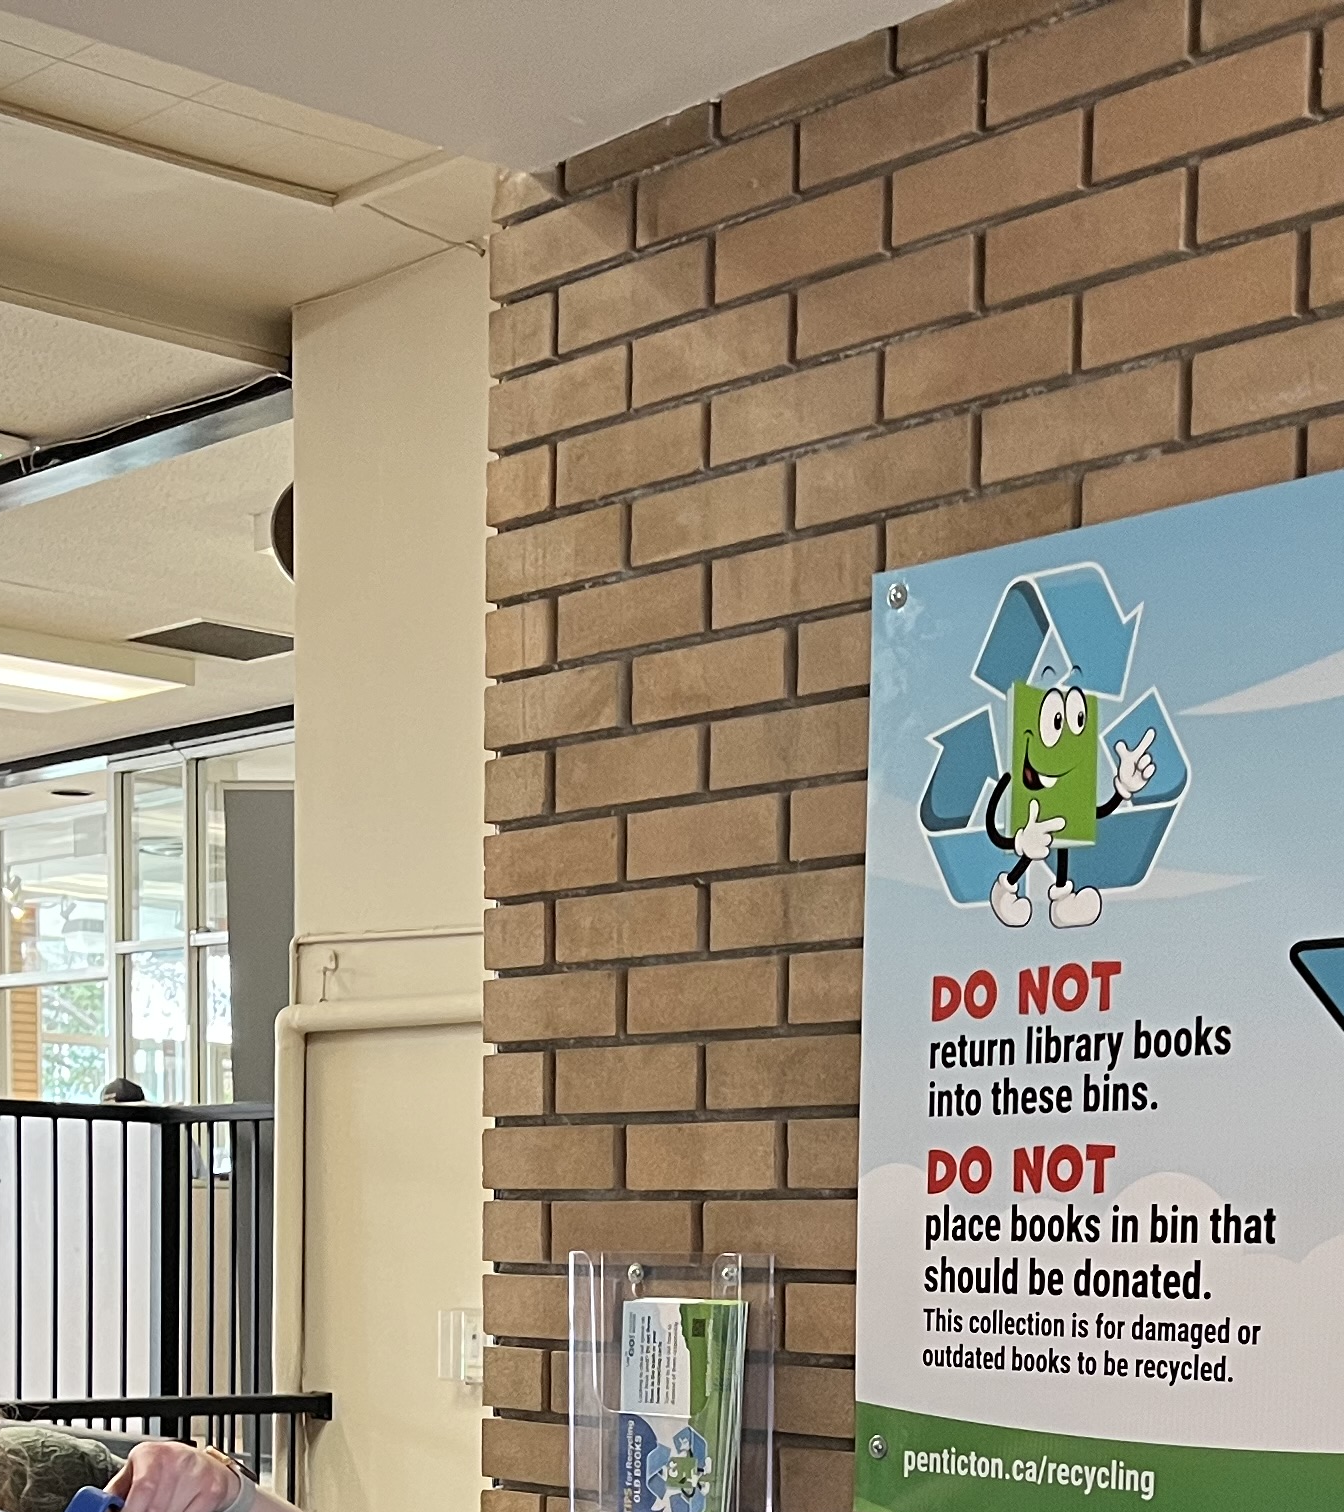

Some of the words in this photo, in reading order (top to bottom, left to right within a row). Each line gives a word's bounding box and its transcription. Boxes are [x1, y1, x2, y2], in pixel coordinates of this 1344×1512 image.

[931, 969, 998, 1022] DO
[1019, 961, 1122, 1015] NOT
[929, 1034, 1015, 1069] return
[1026, 1025, 1124, 1071] library
[1134, 1016, 1232, 1060] books
[928, 1081, 982, 1118] into
[991, 1077, 1072, 1115] these
[1083, 1074, 1158, 1114] bins.
[927, 1146, 993, 1195] DO
[1013, 1143, 1116, 1195] NOT
[925, 1204, 1001, 1250] place
[1011, 1204, 1101, 1243] books
[1111, 1205, 1139, 1243] in
[1150, 1204, 1198, 1244] bin
[1209, 1203, 1277, 1245] that
[924, 1256, 1018, 1295] should
[1028, 1258, 1064, 1296] be
[1073, 1258, 1212, 1300] donated.
[923, 1308, 963, 1333] This
[969, 1310, 1065, 1338] collection
[1071, 1313, 1089, 1338] is
[1095, 1314, 1126, 1340] for
[1131, 1314, 1231, 1349] damaged
[1237, 1323, 1262, 1346] or
[922, 1343, 1006, 1371] outdated
[1011, 1346, 1071, 1374] books
[1077, 1351, 1097, 1376] to
[1103, 1350, 1129, 1377] be
[1135, 1354, 1234, 1387] recycled.
[633, 1434, 642, 1477] BOOKS
[902, 1447, 1156, 1501] penticton.ca/recycling
[633, 1478, 642, 1504] OLD
